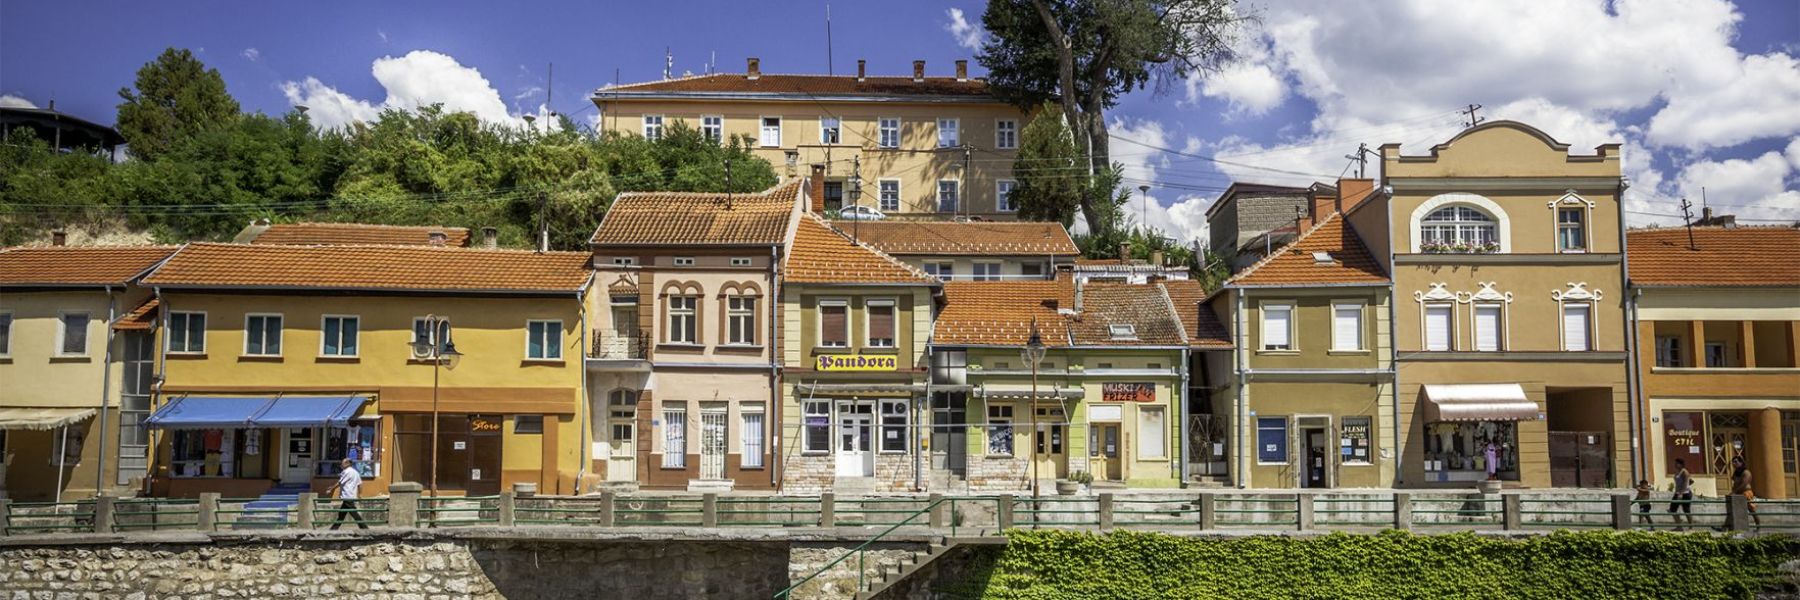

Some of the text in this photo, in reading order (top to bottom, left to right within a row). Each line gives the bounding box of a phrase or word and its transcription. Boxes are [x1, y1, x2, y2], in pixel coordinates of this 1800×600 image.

[819, 356, 895, 368] Pandora
[1103, 392, 1137, 401] FRIZER
[472, 419, 501, 431] Store
[1668, 429, 1700, 438] Boutique
[1675, 438, 1695, 446] STIL
